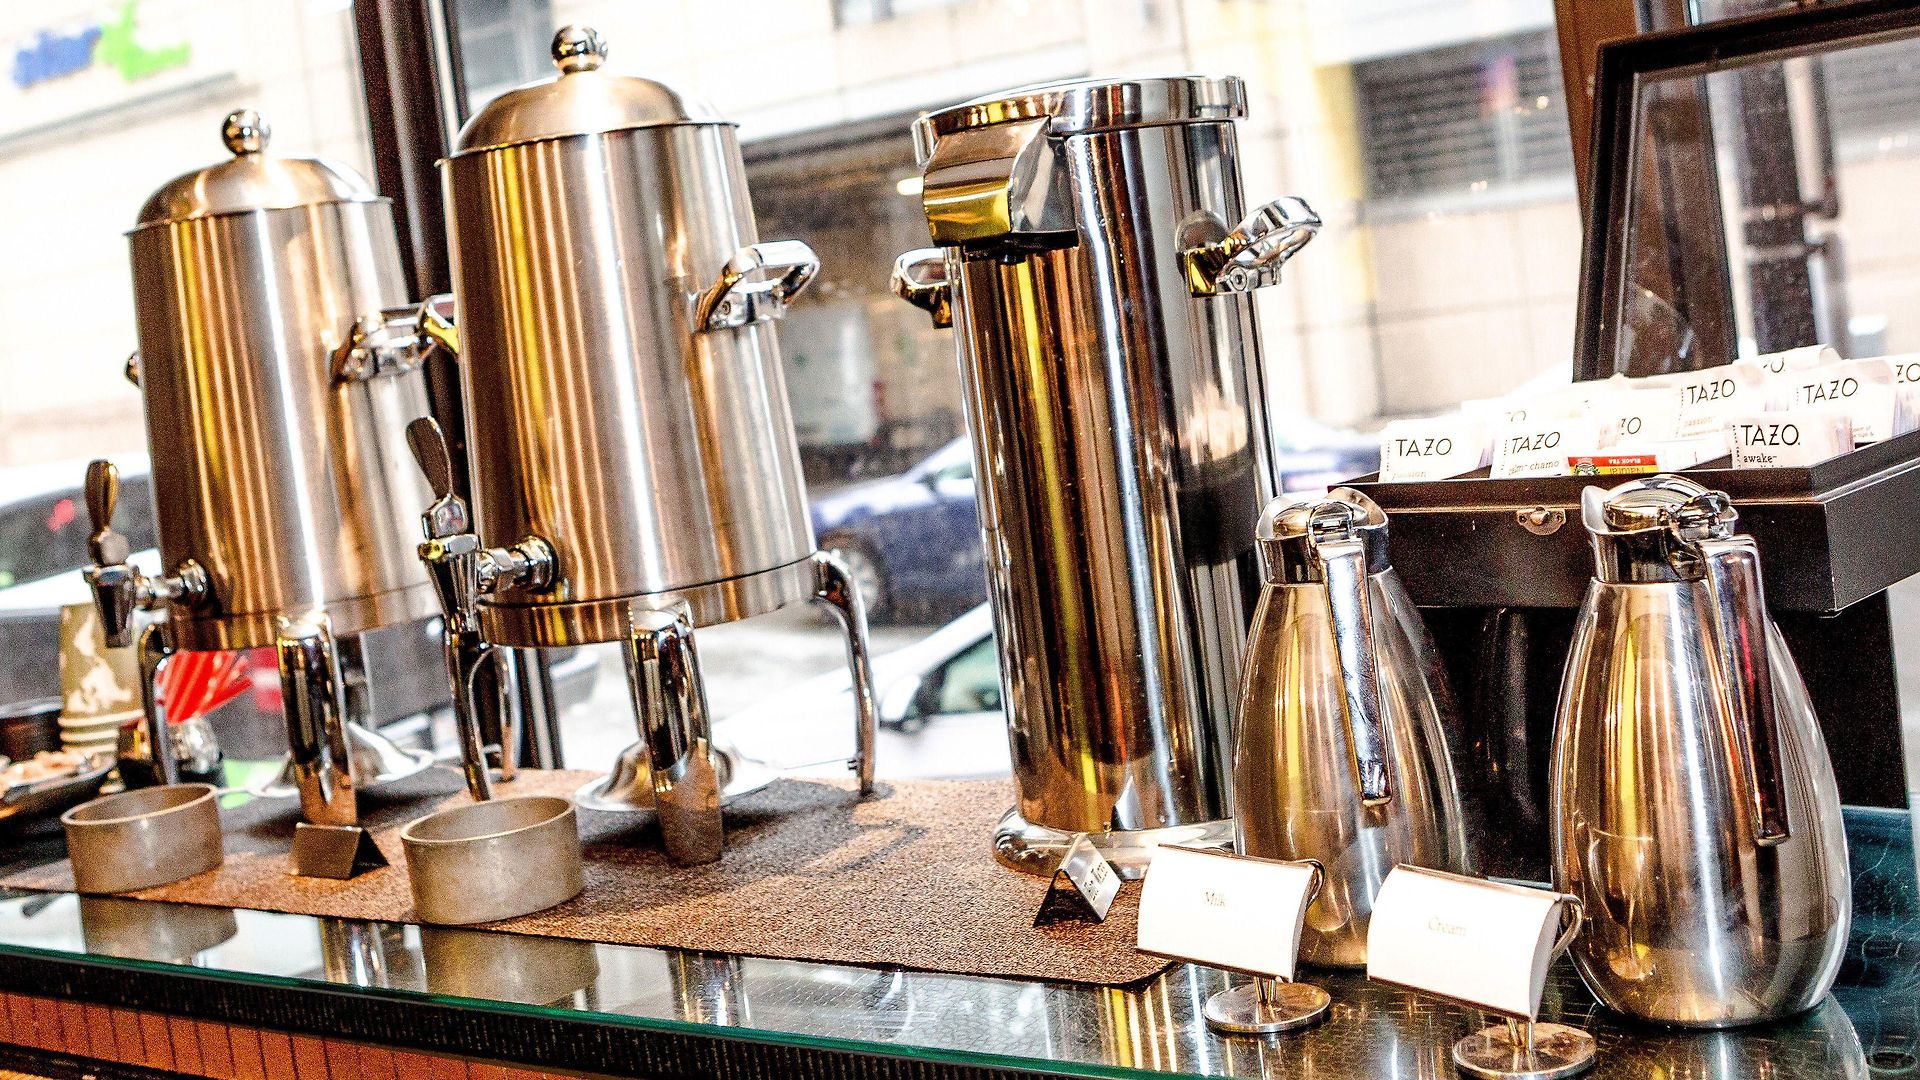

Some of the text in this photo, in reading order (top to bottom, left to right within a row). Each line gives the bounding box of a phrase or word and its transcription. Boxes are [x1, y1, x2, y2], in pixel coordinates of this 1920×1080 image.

[1686, 379, 1735, 404] TAZO
[1803, 377, 1858, 404] TAZO
[1511, 431, 1561, 454] TAZO
[1741, 424, 1800, 446] TAZO
[1395, 438, 1452, 456] TAZO
[1205, 891, 1226, 907] Milk
